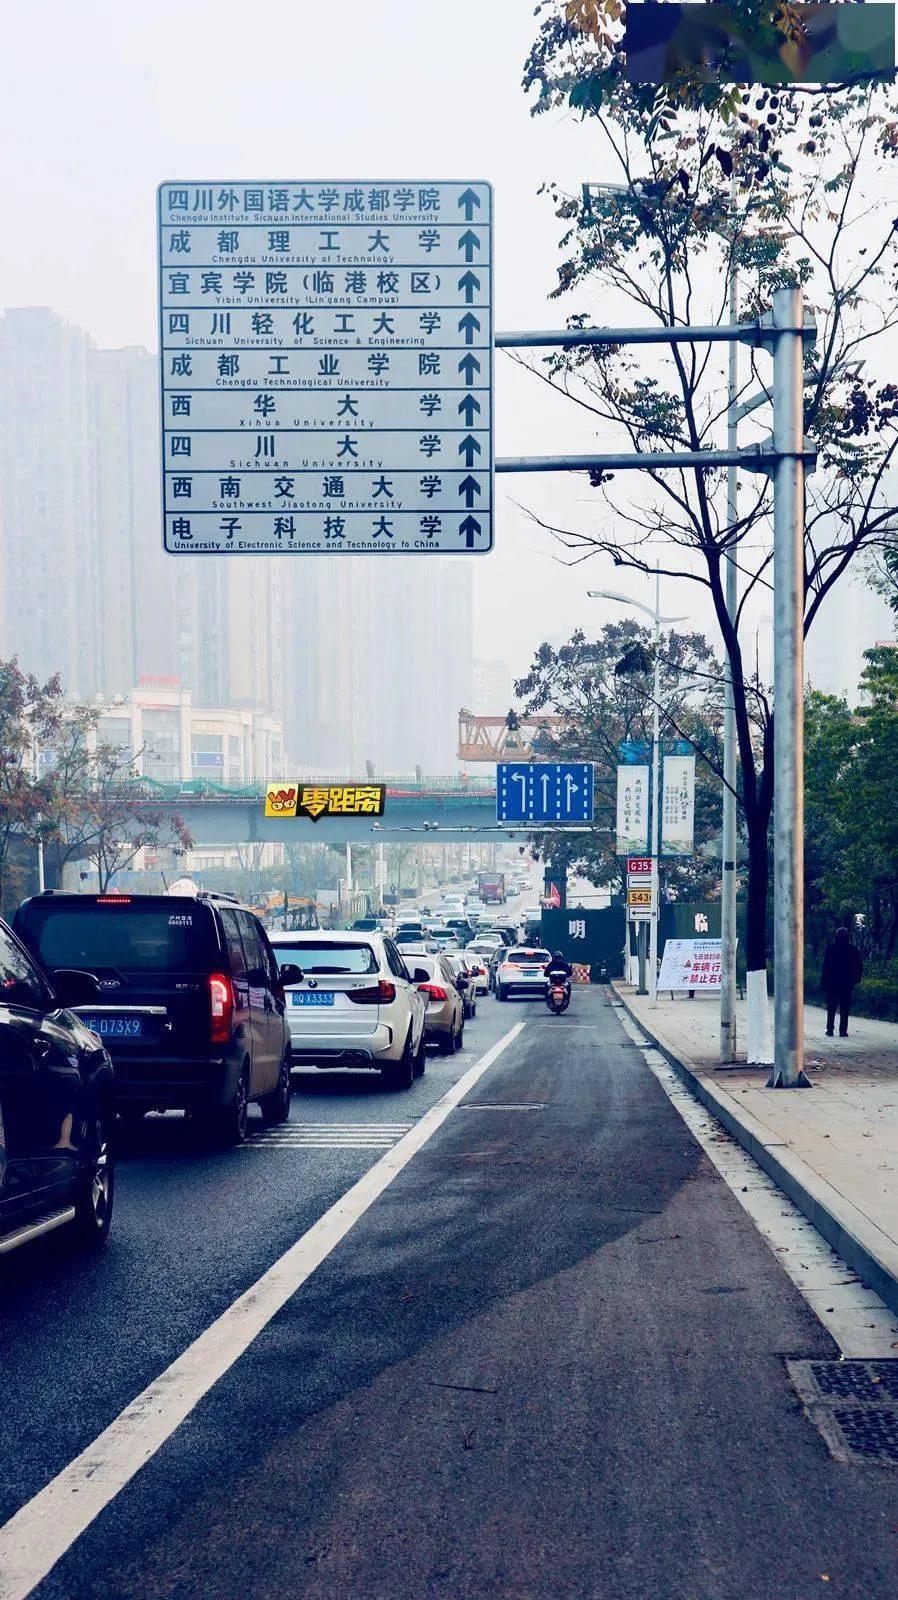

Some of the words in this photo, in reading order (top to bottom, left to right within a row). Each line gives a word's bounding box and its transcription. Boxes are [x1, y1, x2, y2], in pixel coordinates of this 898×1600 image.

[168, 188, 440, 212] 四川外国语大学成都学院
[170, 214, 208, 223] Chengdu
[211, 214, 248, 222] Institute
[254, 214, 290, 222] Sichuan
[291, 214, 350, 222] International
[355, 214, 388, 222] Studies
[392, 214, 439, 223] University
[169, 229, 440, 253] 成都理工大学
[212, 255, 255, 265] Chengdu
[262, 256, 316, 264] University
[322, 256, 331, 264] of
[336, 256, 394, 265] Technology
[248, 297, 299, 305] University
[357, 296, 398, 304] Campus)
[169, 312, 441, 335] 四川轻化工大学
[369, 337, 424, 346] Engineering
[171, 353, 440, 376] 成都工业学院
[216, 379, 257, 387] Chengdu
[264, 378, 331, 387] Technological
[338, 379, 389, 387] University
[170, 394, 441, 417] 西华大学
[294, 419, 373, 427] University
[171, 434, 441, 457] 四川大学
[231, 460, 288, 468] Sichuan
[303, 460, 382, 468] University
[172, 475, 441, 498] 西南交通大学
[281, 501, 331, 509] Jiaotong
[173, 516, 441, 540] 电子科技大学
[174, 541, 221, 551] University
[225, 541, 234, 550] of
[238, 541, 283, 550] Electronic
[326, 541, 342, 550] and
[346, 541, 397, 551] Technology
[414, 541, 440, 550] China
[300, 786, 382, 817] 零距离
[568, 920, 586, 939] 明
